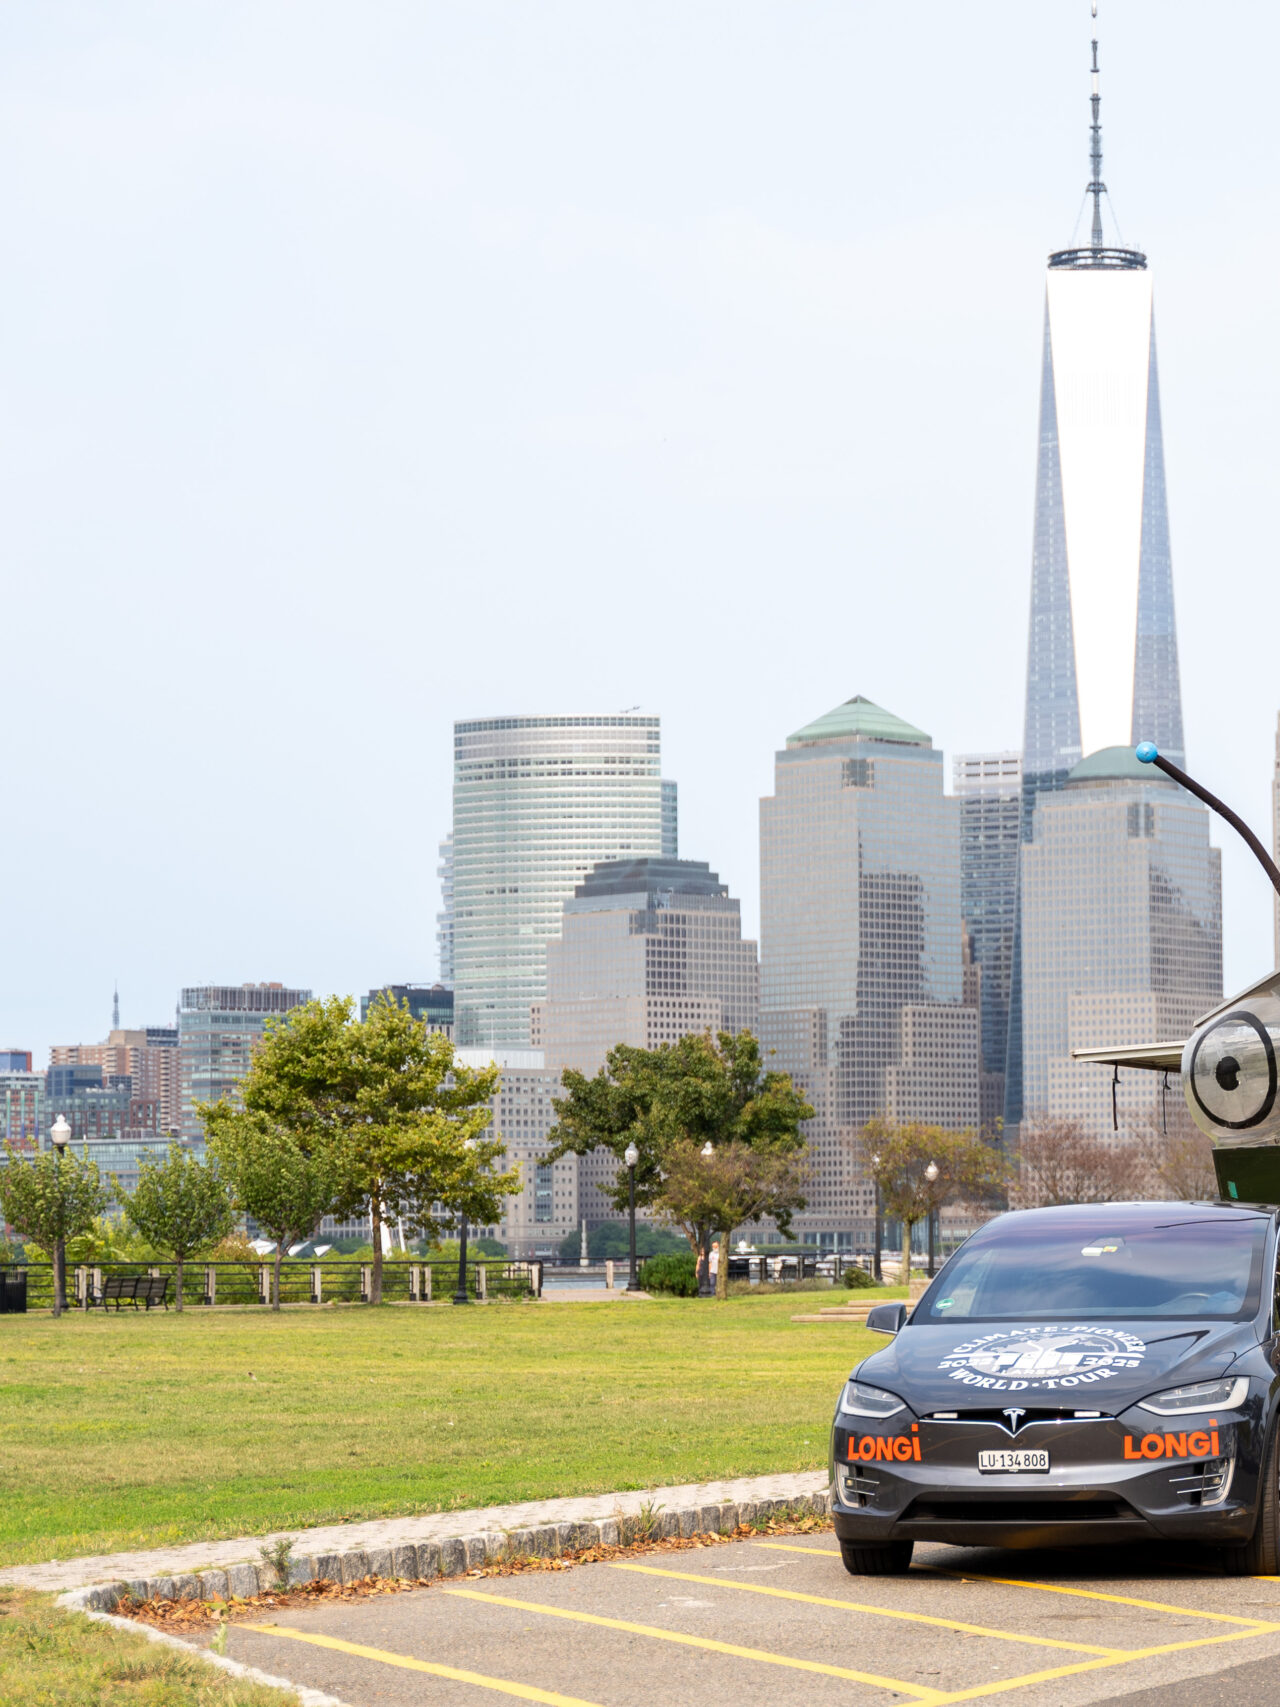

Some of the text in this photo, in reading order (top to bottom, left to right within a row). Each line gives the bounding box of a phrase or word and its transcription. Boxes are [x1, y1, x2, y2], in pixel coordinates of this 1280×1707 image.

[952, 1325, 1147, 1354] CLIMATE PIONEER
[1082, 1357, 1140, 1368] 2025
[948, 1368, 1119, 1391] WORLD TOUR
